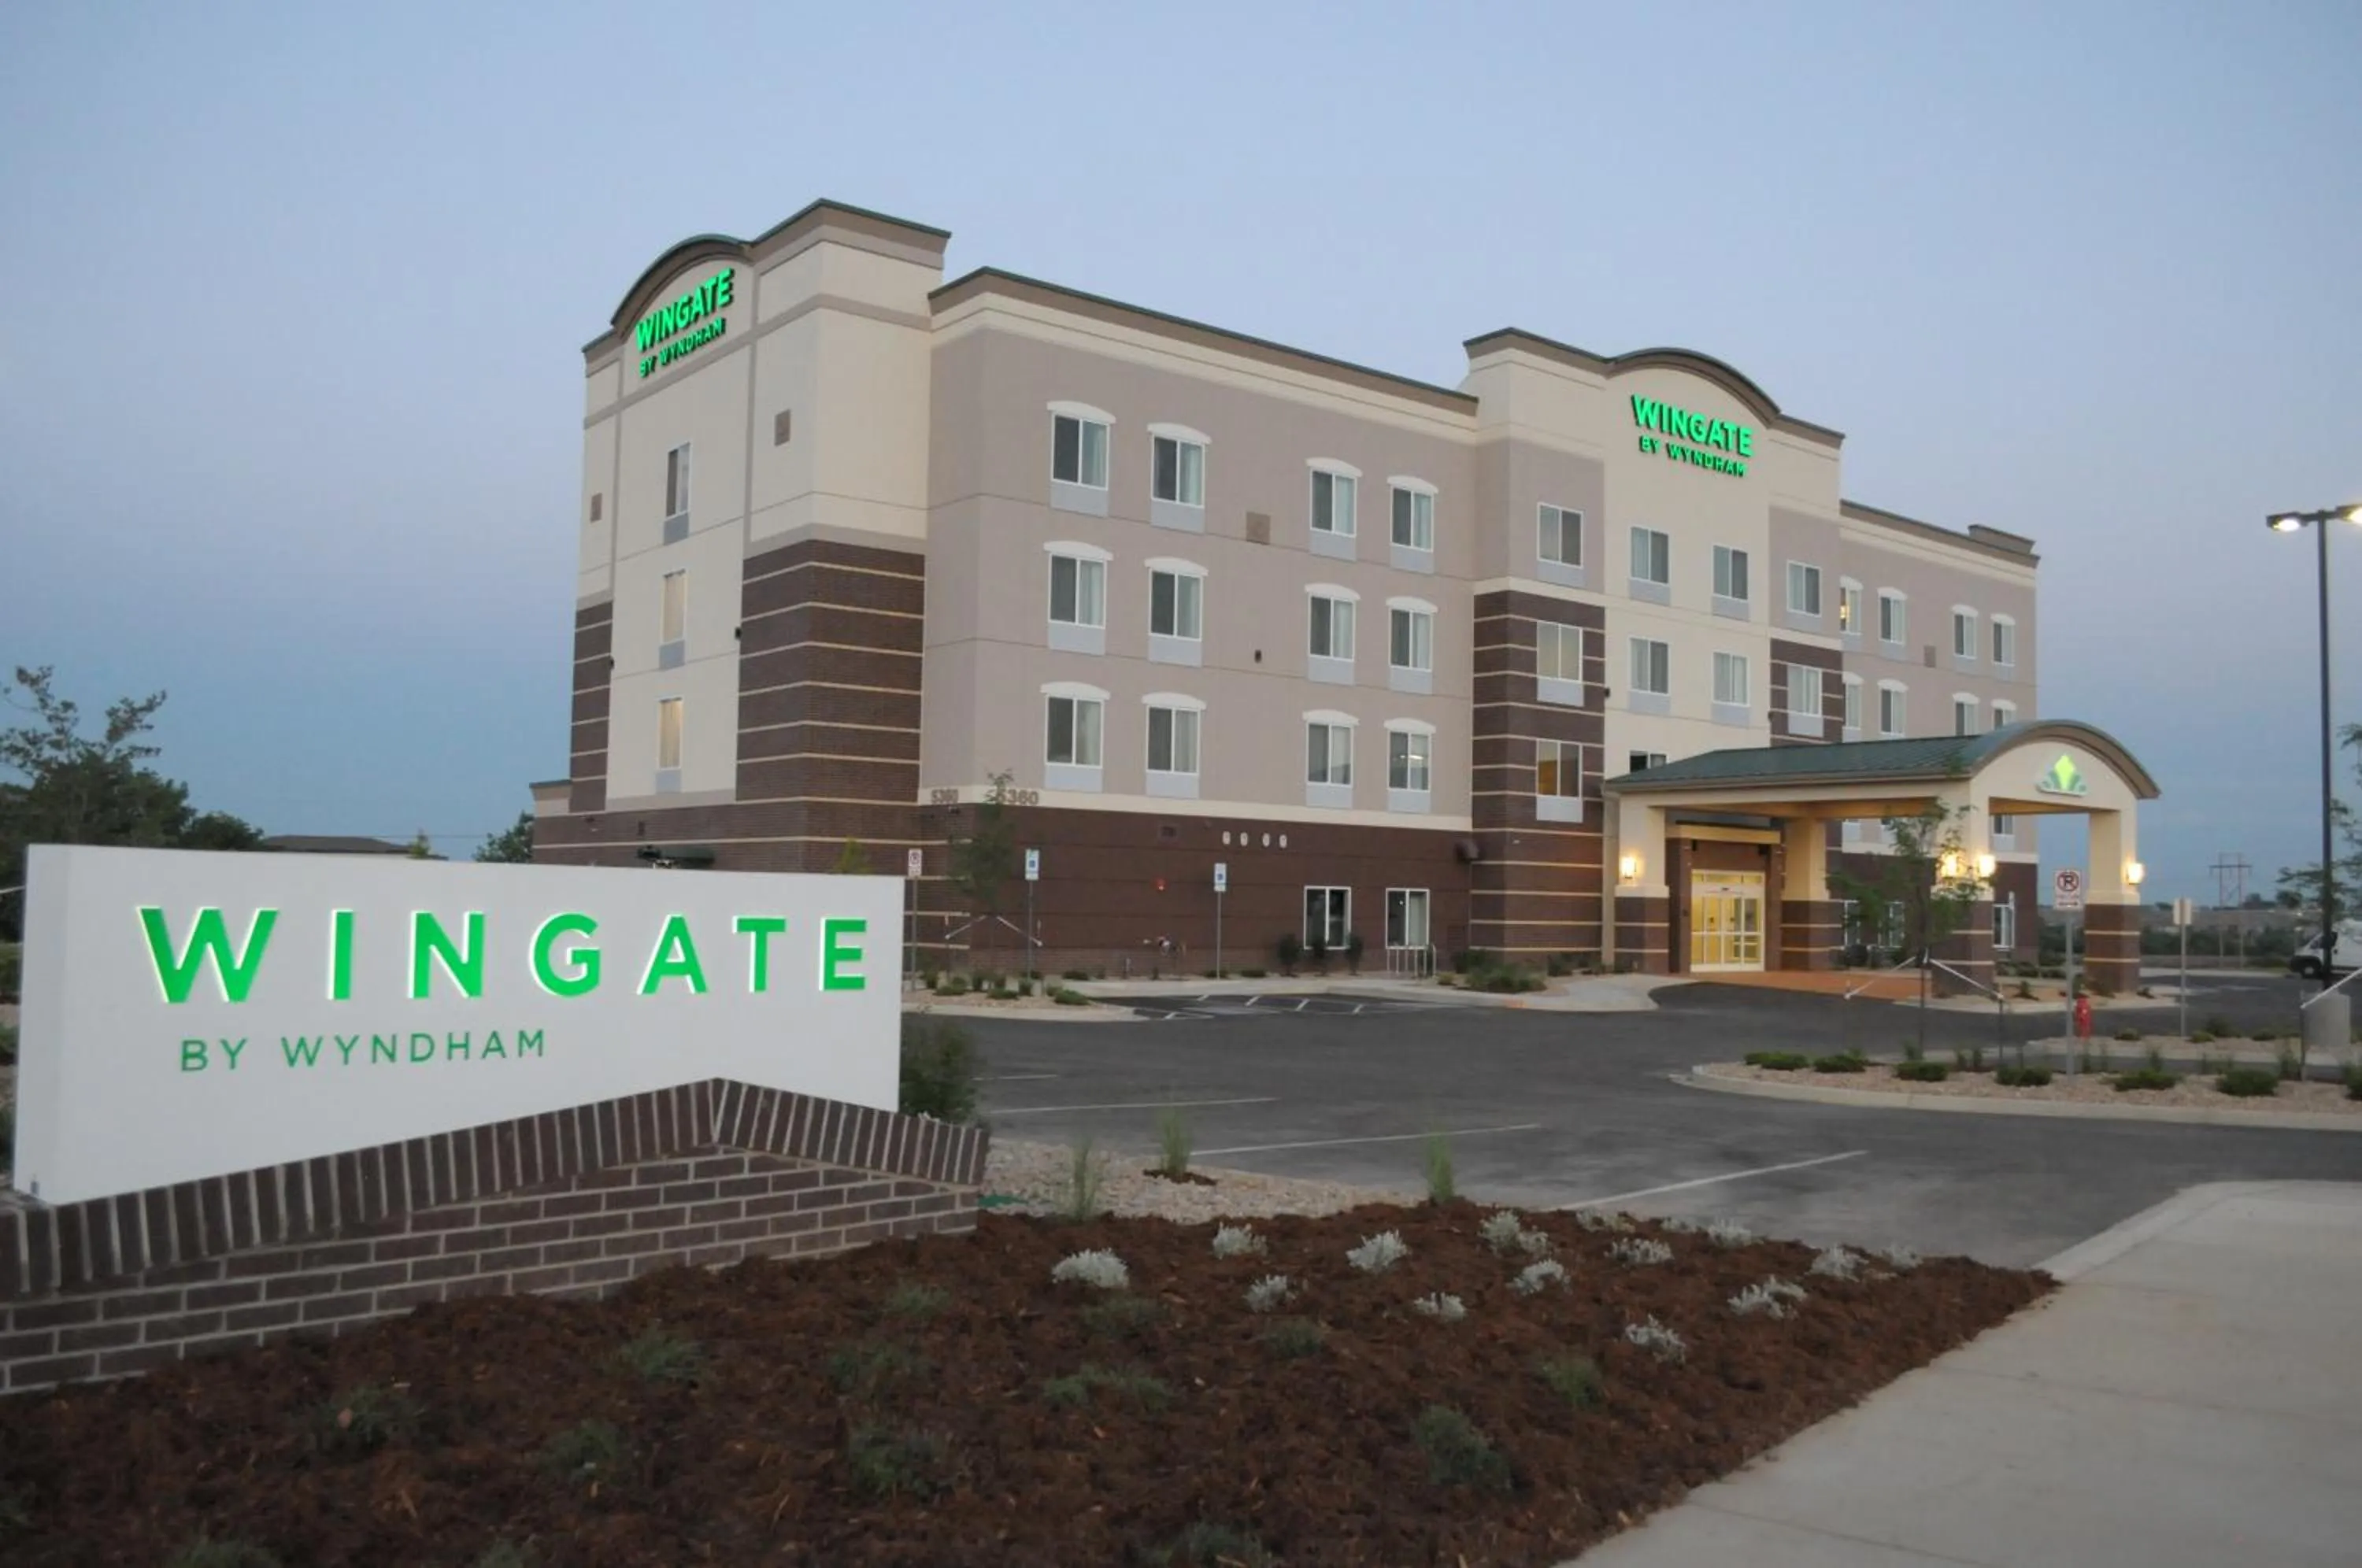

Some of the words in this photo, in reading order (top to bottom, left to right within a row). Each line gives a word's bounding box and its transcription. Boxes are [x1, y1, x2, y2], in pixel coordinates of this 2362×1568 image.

[635, 268, 735, 352] WINGATE
[639, 356, 657, 378] BY
[660, 316, 727, 366] WYNDHAM
[1631, 394, 1754, 457] WINGATE
[1639, 435, 1660, 453] BY
[1666, 442, 1747, 478] WYNDHAM
[137, 906, 867, 1004] WINGATE
[180, 1037, 248, 1071] BY
[281, 1030, 545, 1067] WYNDHAM
